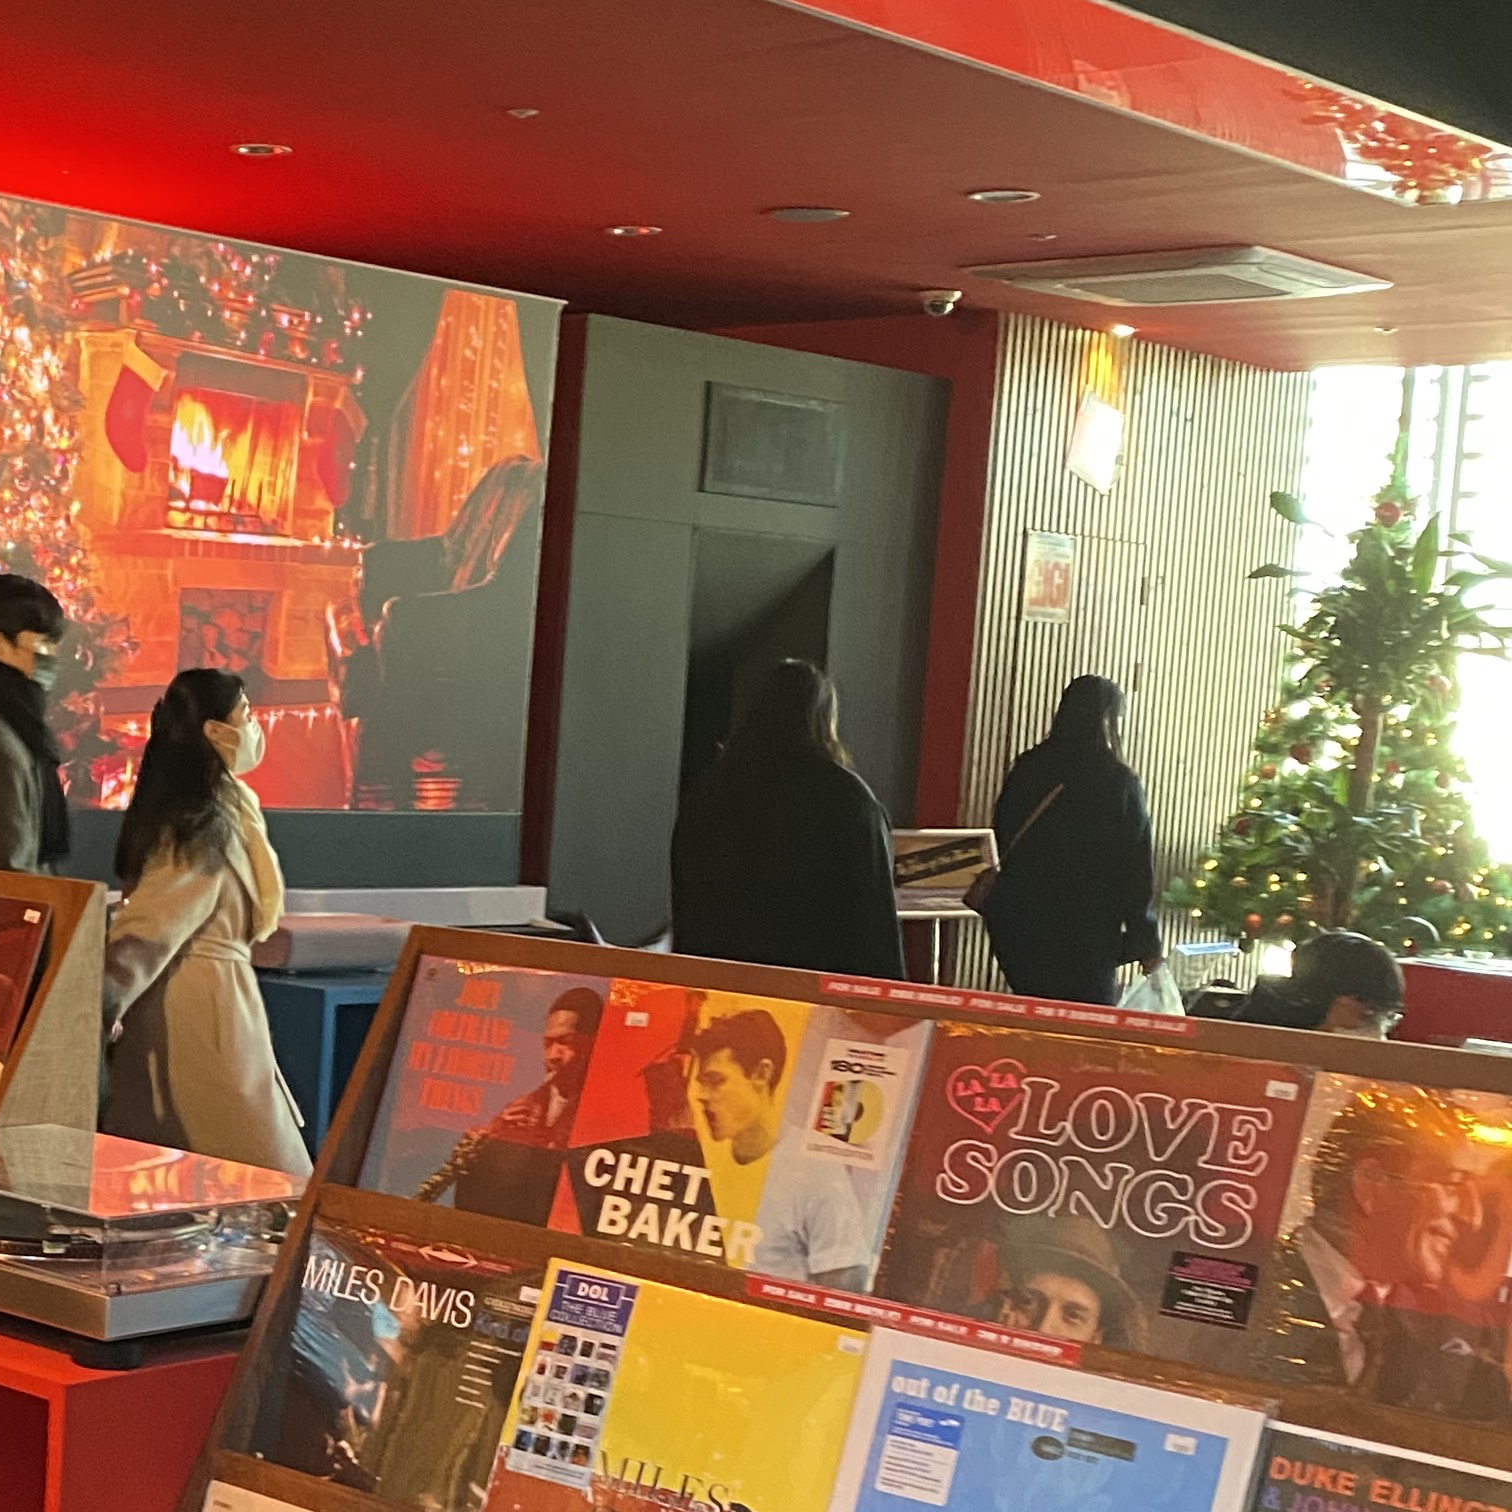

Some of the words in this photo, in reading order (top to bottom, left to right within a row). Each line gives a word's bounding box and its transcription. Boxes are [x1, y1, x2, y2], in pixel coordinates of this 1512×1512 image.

[1010, 1077, 1272, 1176] LOVE
[584, 1147, 712, 1206] CHET
[936, 1140, 1258, 1249] SONGS
[597, 1194, 762, 1265] BAKER
[302, 1256, 384, 1305] MILES
[390, 1276, 476, 1328] DAVIS
[890, 1375, 930, 1399] out
[933, 1383, 961, 1407] of
[962, 1388, 1001, 1416] the
[1004, 1396, 1069, 1432] BLUE
[1269, 1455, 1358, 1497] DUKE
